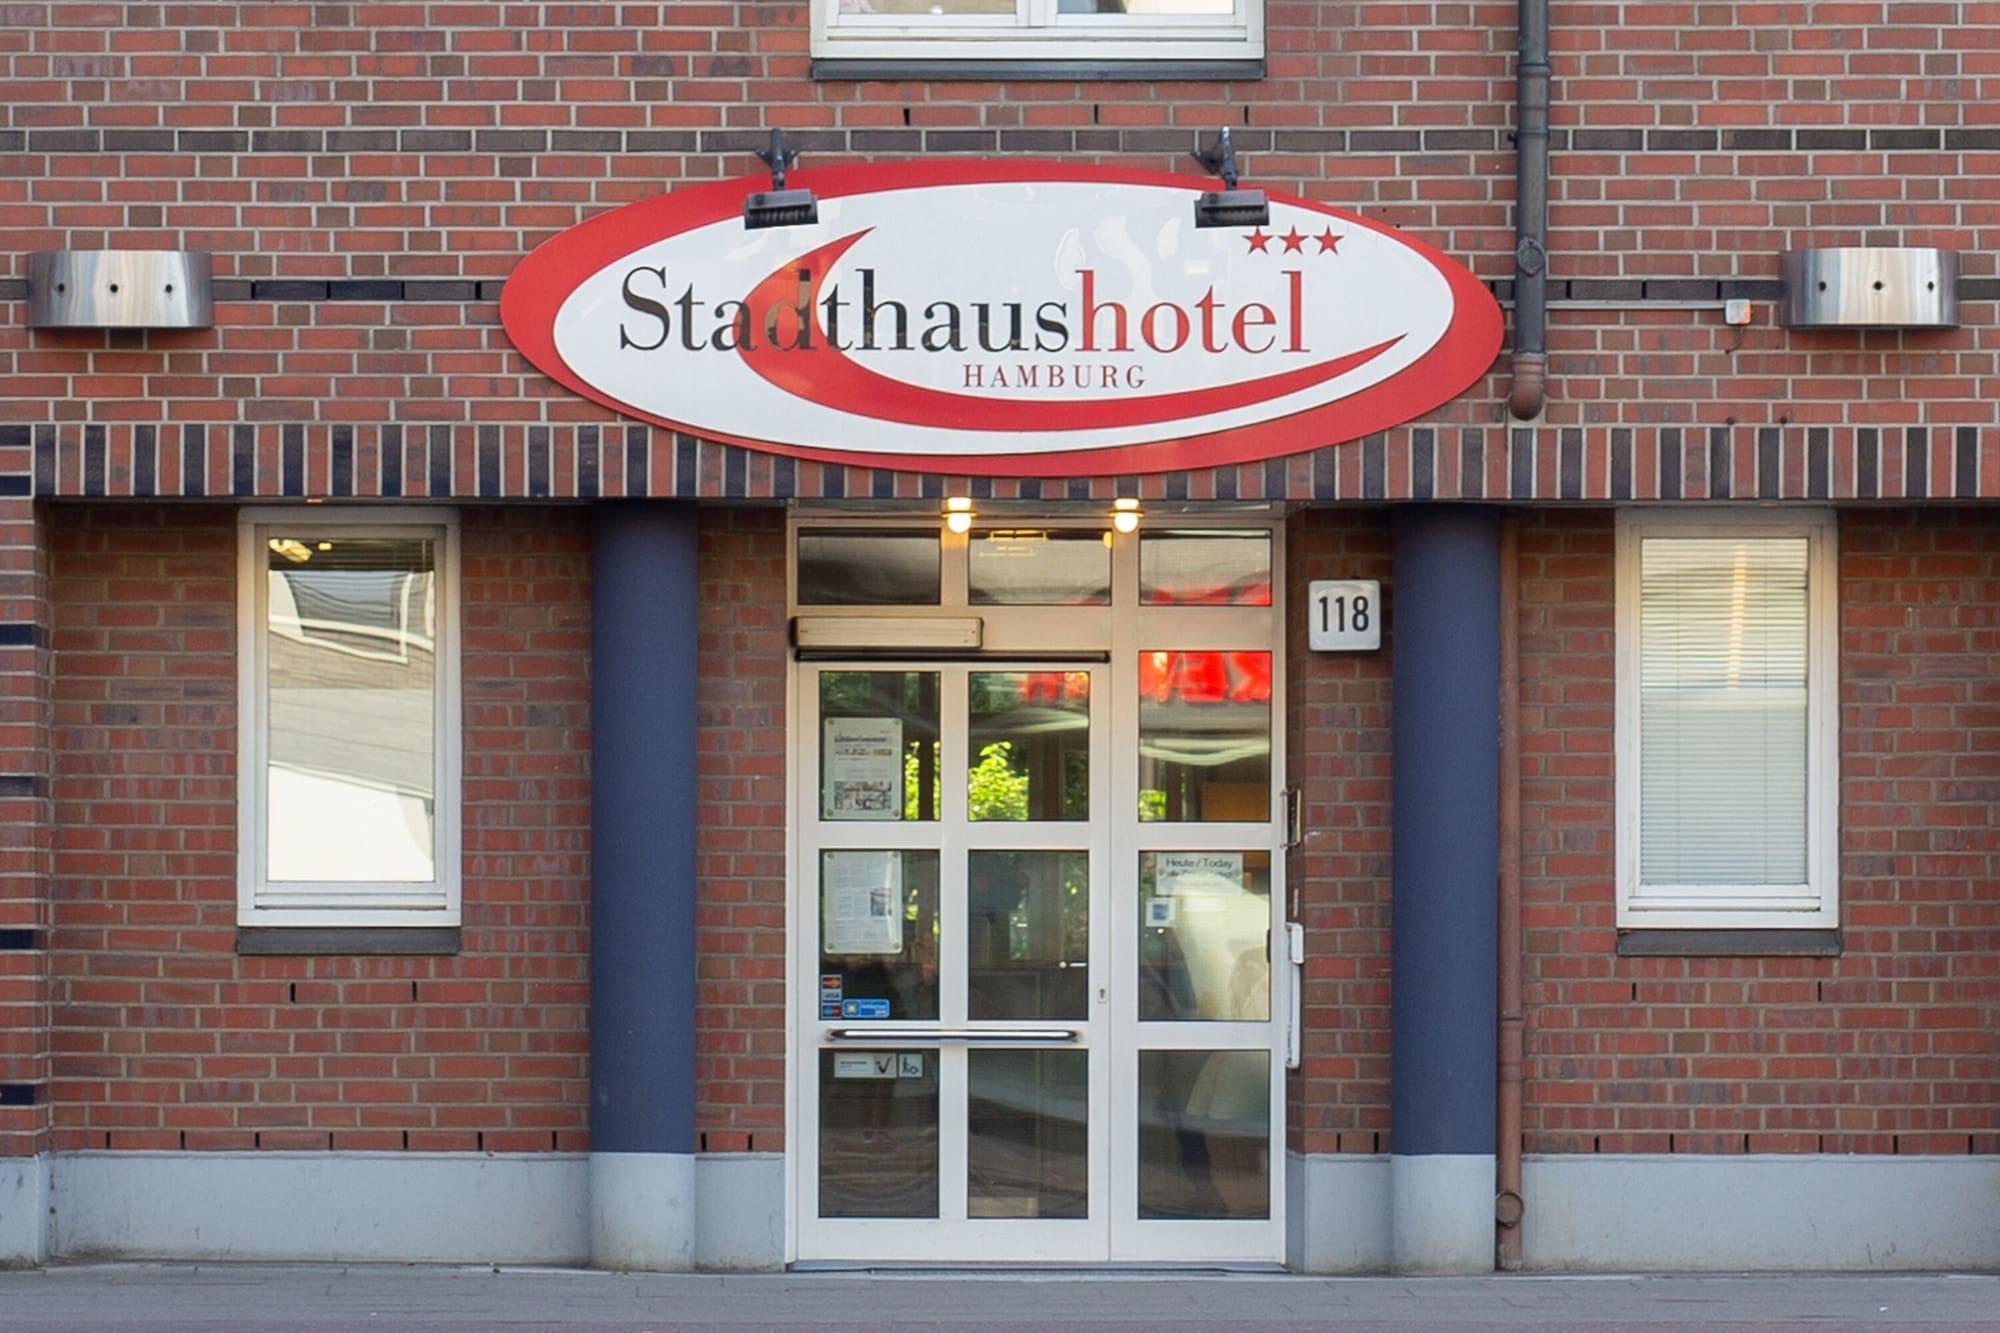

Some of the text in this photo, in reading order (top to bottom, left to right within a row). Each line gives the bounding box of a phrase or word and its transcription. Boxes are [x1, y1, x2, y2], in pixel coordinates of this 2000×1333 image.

[620, 266, 1311, 353] Stadthaushotel
[963, 364, 1146, 389] HAMBURG
[1318, 595, 1369, 632] 118
